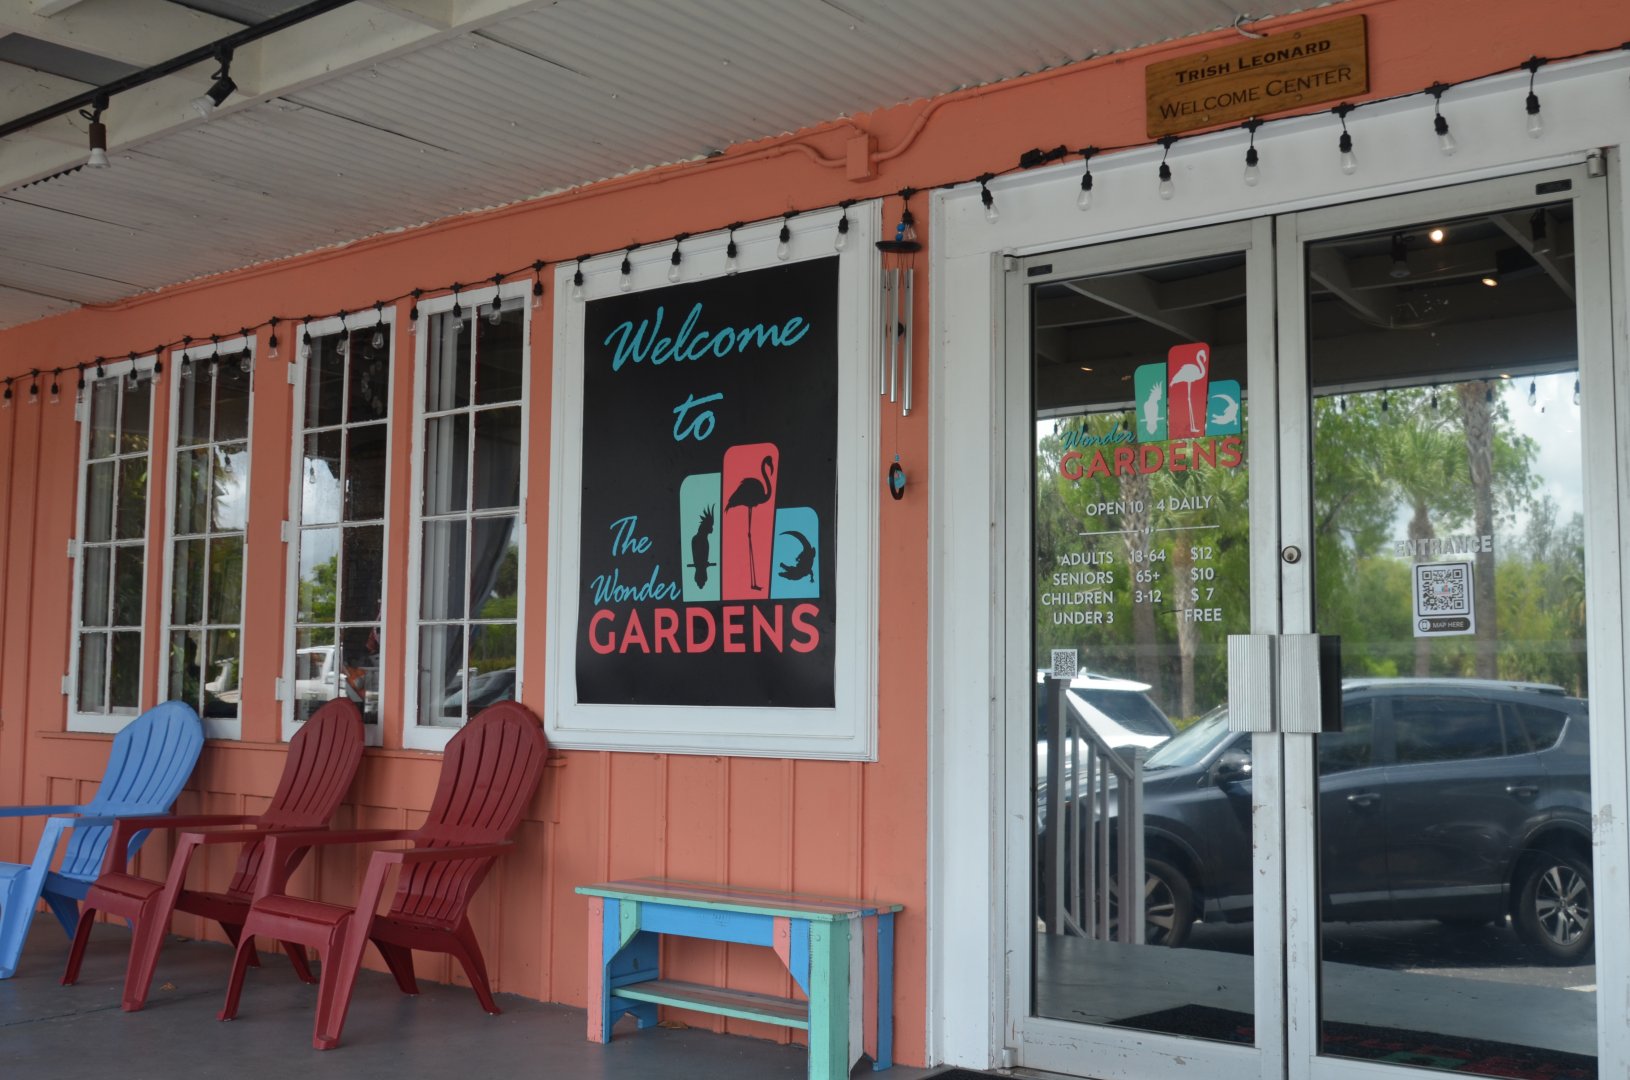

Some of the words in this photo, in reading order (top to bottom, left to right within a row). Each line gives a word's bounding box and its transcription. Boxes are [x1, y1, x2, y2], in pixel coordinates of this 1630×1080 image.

[1175, 62, 1230, 84] TRISH
[1238, 40, 1331, 70] LEONARD
[1160, 86, 1260, 119] WELCOME
[1266, 67, 1351, 97] CENTER
[604, 302, 810, 372] Welcome
[673, 392, 724, 442] to
[1060, 422, 1137, 450] Wonder
[1059, 437, 1243, 481] GARDENS
[1086, 502, 1126, 517] OPEN
[1130, 501, 1144, 514] 10
[1157, 499, 1165, 511] 4
[1169, 495, 1213, 511] DAILY
[609, 515, 652, 557] The
[1061, 551, 1114, 566] ADULTS
[1130, 548, 1167, 563] 13-64
[1190, 546, 1213, 562] $12
[1394, 535, 1493, 557] ENTRANCE
[590, 565, 681, 605] Wonder
[1052, 571, 1114, 586] SENIORS
[1135, 569, 1161, 583] 65+
[1190, 567, 1215, 582] $10
[1041, 591, 1114, 606] CHILDREN
[1135, 590, 1162, 604] 3-12
[1053, 611, 1103, 625] UNDER
[1106, 610, 1114, 624] 3
[1184, 608, 1222, 622] FREE
[588, 602, 820, 655] GARDENS
